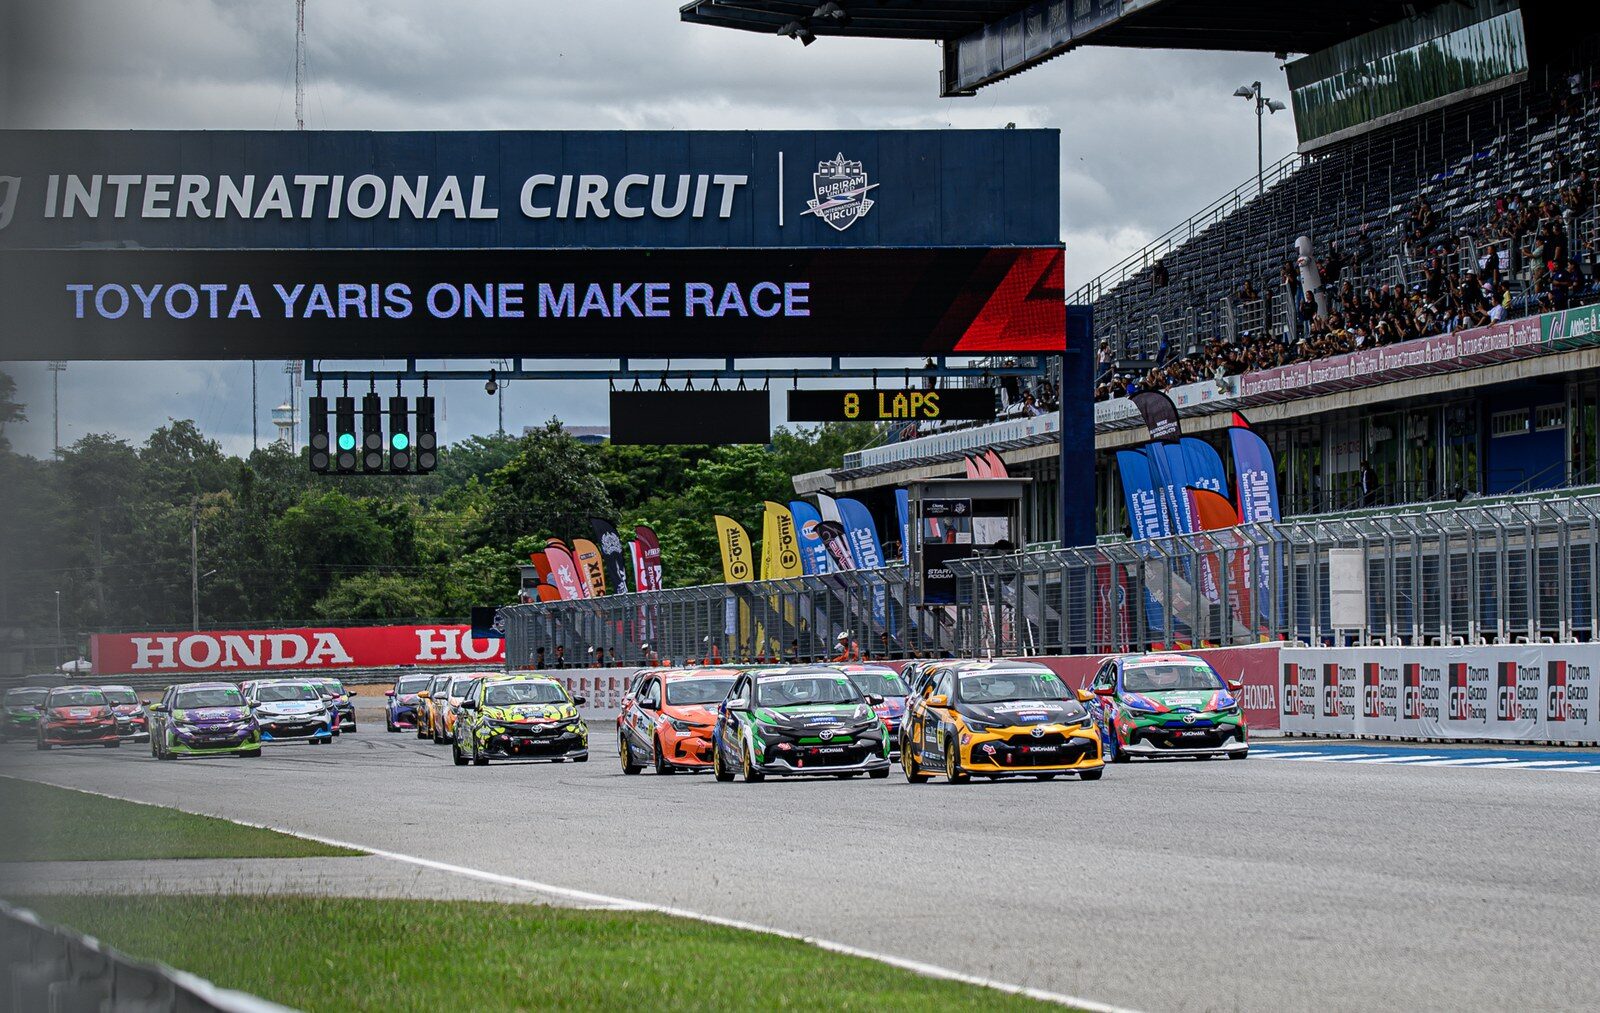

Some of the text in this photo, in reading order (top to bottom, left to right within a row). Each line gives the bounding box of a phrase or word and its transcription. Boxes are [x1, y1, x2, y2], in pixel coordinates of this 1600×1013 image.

[818, 176, 864, 195] BURIRAM
[44, 173, 499, 219] INTERNATIONAL
[520, 173, 748, 219] CIRCUIT
[824, 201, 861, 214] INTERNATIONAL
[824, 206, 862, 222] CIRCUIT
[66, 282, 811, 319] TOYOTA YARIS ONE MAKE RACE
[843, 392, 940, 419] 8 LAPS
[131, 632, 354, 668] HONDA
[1299, 666, 1317, 681] TOYOTA
[1339, 666, 1357, 681] TOYOTA
[1380, 666, 1399, 682] TOYOTA
[1421, 666, 1441, 682] TOYOTA
[1468, 666, 1489, 682] TOYOTA
[1518, 665, 1541, 681] TOYOTA
[1567, 664, 1590, 681] TOYOTA
[1243, 685, 1276, 710] HONDA
[1299, 684, 1316, 698] GAZOO
[1339, 684, 1355, 698] GAZOO
[1380, 684, 1397, 699] GAZOO
[1421, 685, 1440, 700] GAZOO
[1468, 685, 1488, 700] GAZOO
[1517, 685, 1538, 700] GAZOO
[1567, 684, 1589, 700] GAZOO
[1299, 700, 1316, 719] Racing
[1339, 701, 1355, 720] Racing
[1380, 702, 1397, 722] Racing
[1421, 703, 1440, 723] Racing
[1468, 703, 1487, 724] Racing
[1517, 703, 1538, 725] Racing
[1567, 703, 1588, 726] Racing
